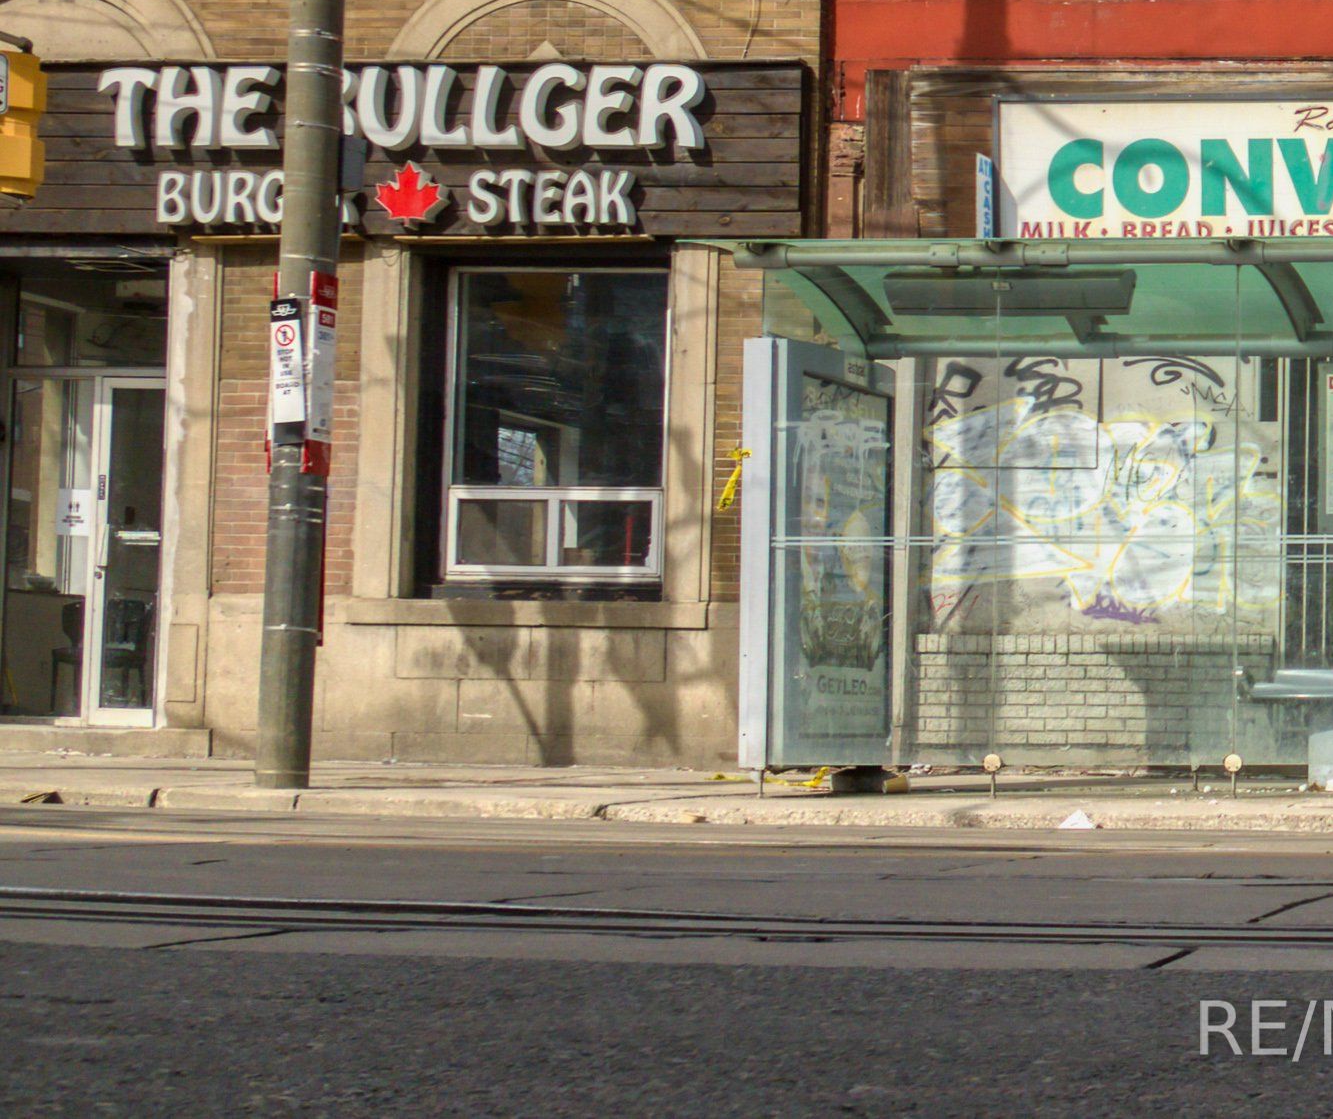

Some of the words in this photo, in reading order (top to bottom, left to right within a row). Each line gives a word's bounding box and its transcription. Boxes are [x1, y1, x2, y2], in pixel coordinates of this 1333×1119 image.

[98, 66, 280, 149] THE
[467, 169, 636, 226] STEAK
[1020, 220, 1092, 238] MILK
[1121, 220, 1214, 238] BREAD
